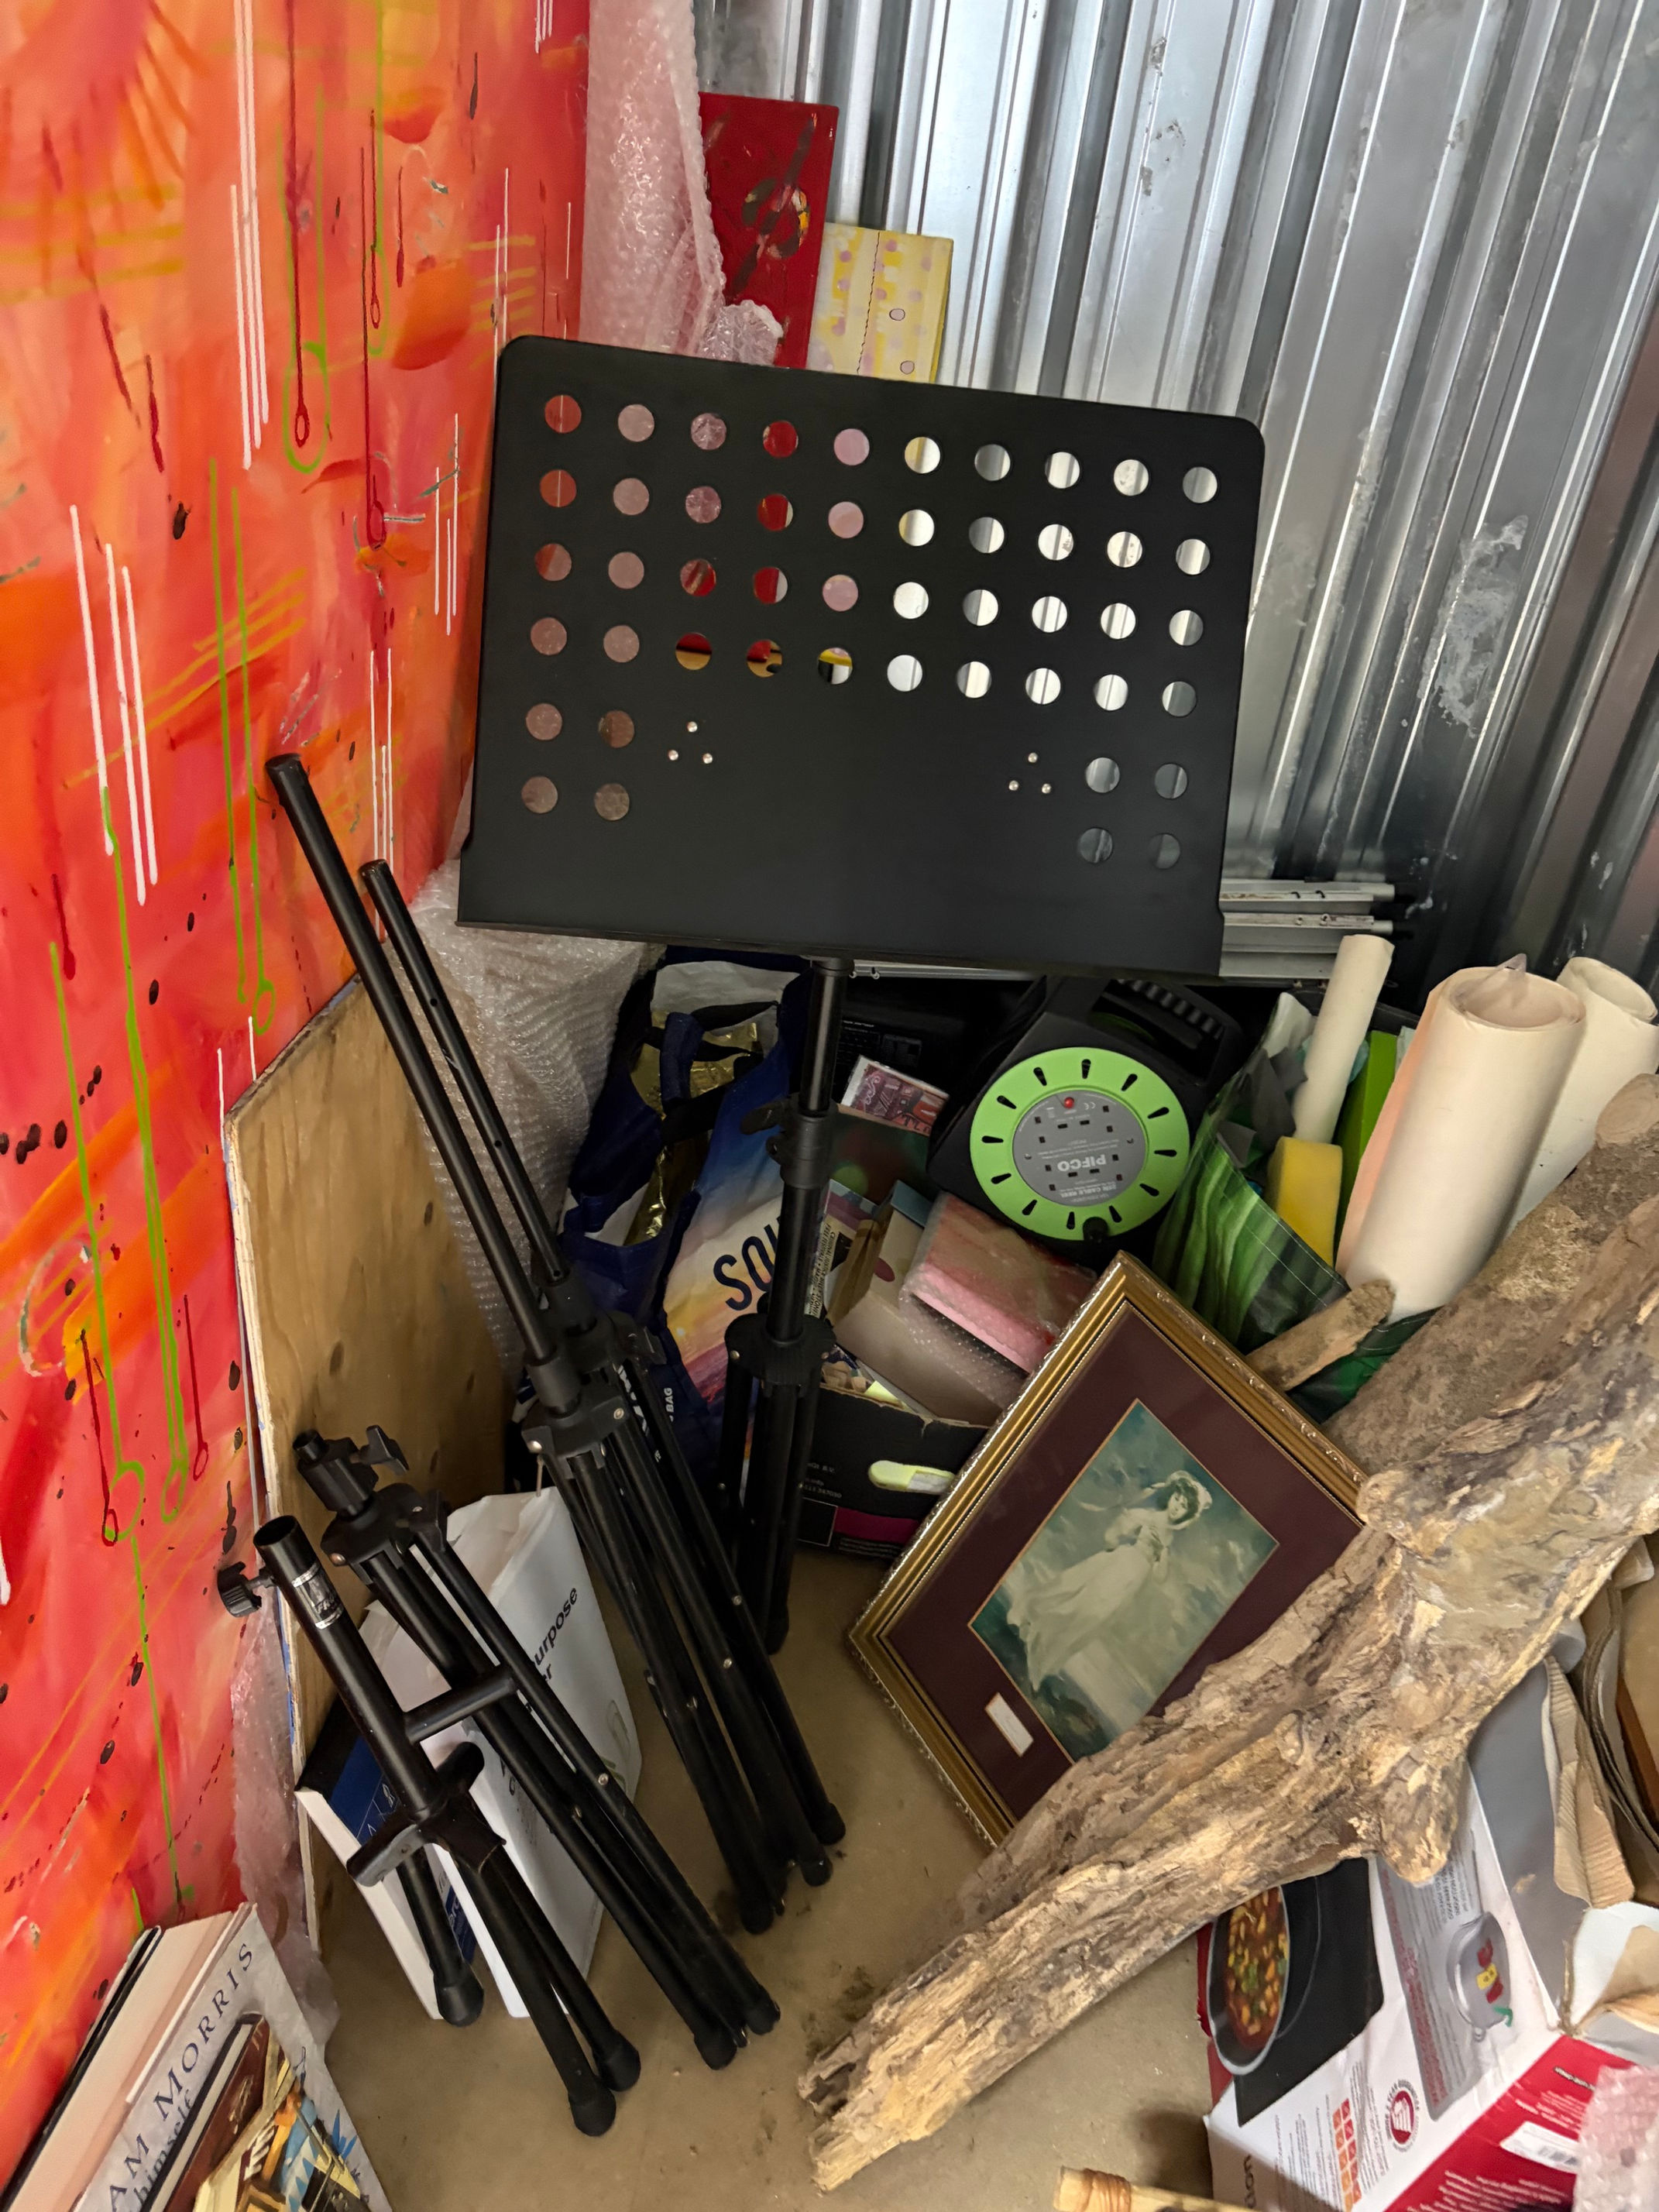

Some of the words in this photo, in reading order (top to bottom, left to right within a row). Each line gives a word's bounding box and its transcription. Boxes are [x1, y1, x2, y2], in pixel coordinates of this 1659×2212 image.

[1057, 1154, 1107, 1172] PIFCO
[664, 1387, 675, 1413] BAG
[531, 1587, 578, 1666] urpose
[153, 1942, 253, 2121] MORRIS
